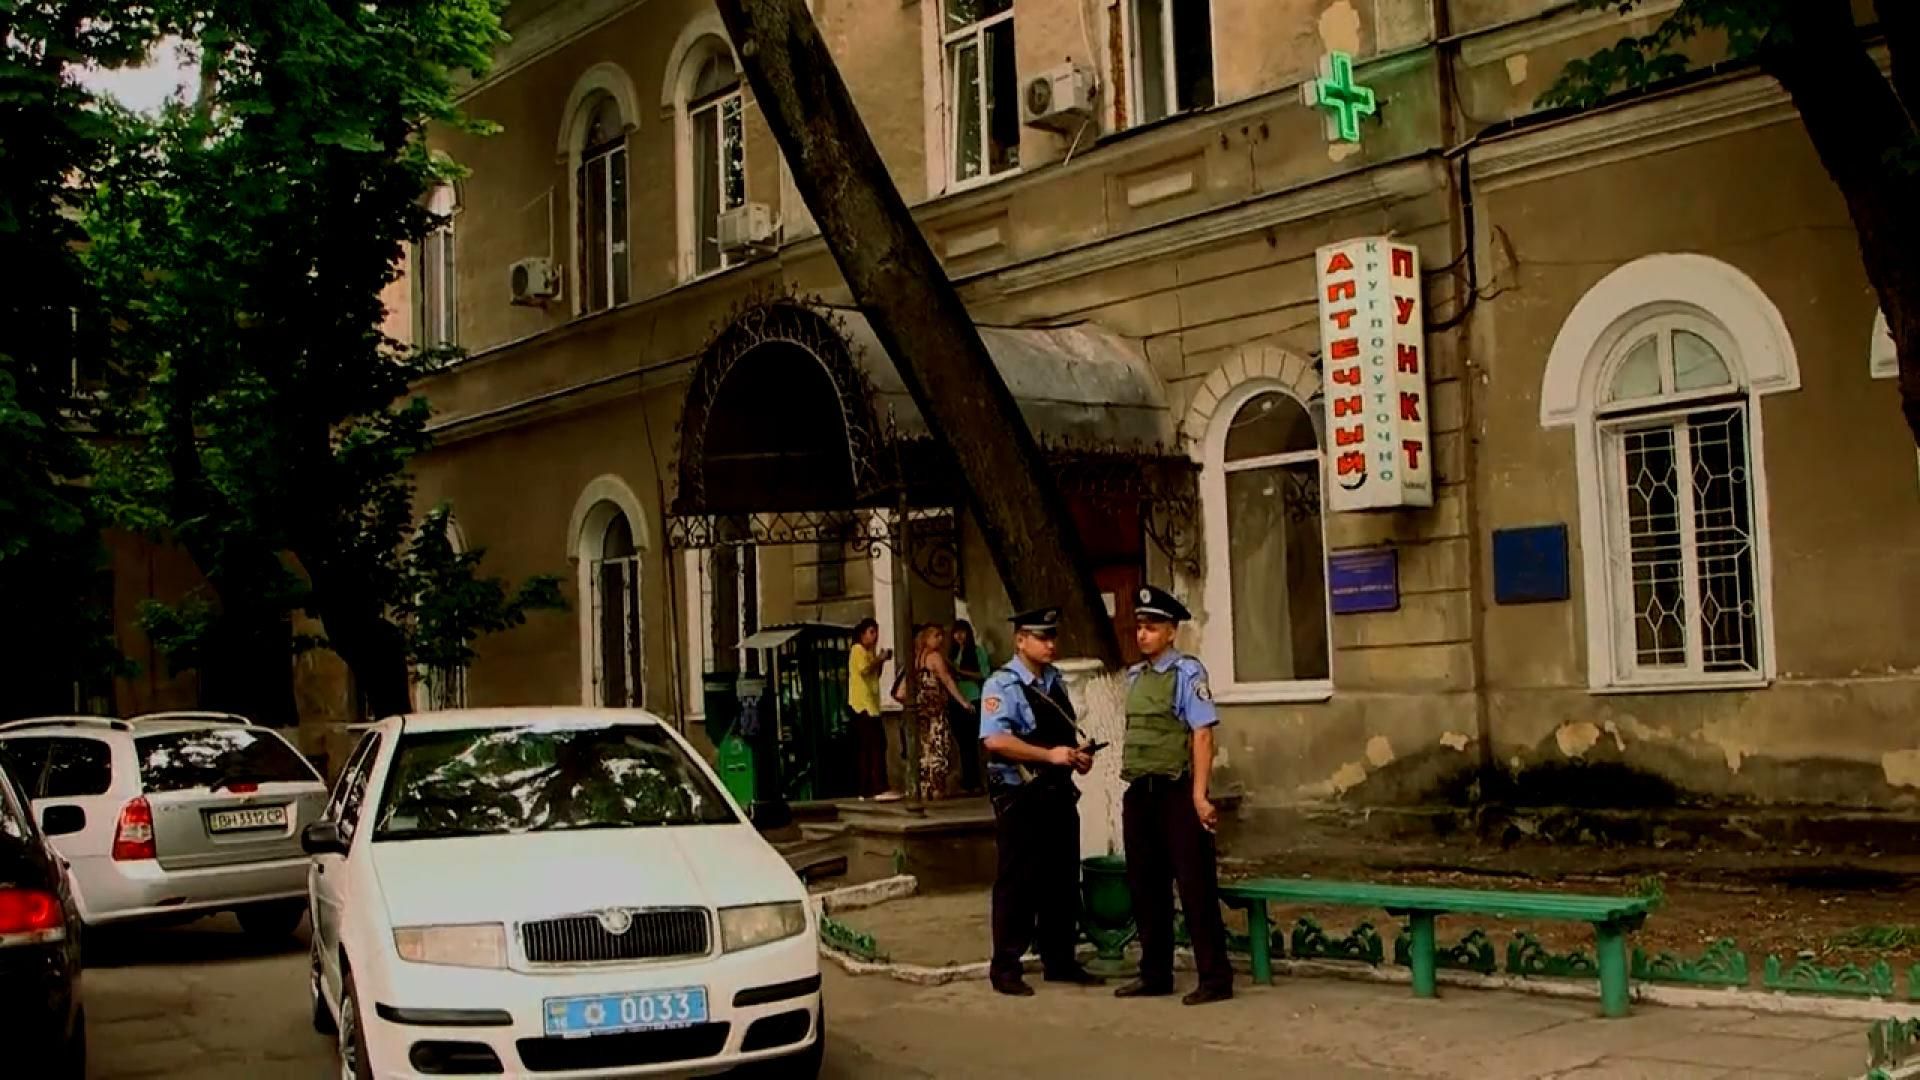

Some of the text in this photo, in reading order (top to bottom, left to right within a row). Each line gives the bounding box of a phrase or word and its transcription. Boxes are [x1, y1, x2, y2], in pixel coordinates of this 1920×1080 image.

[1327, 252, 1365, 475] АПТЕЧНЫЙ
[1392, 249, 1422, 469] ПУНКТ
[621, 993, 691, 1023] 0033
